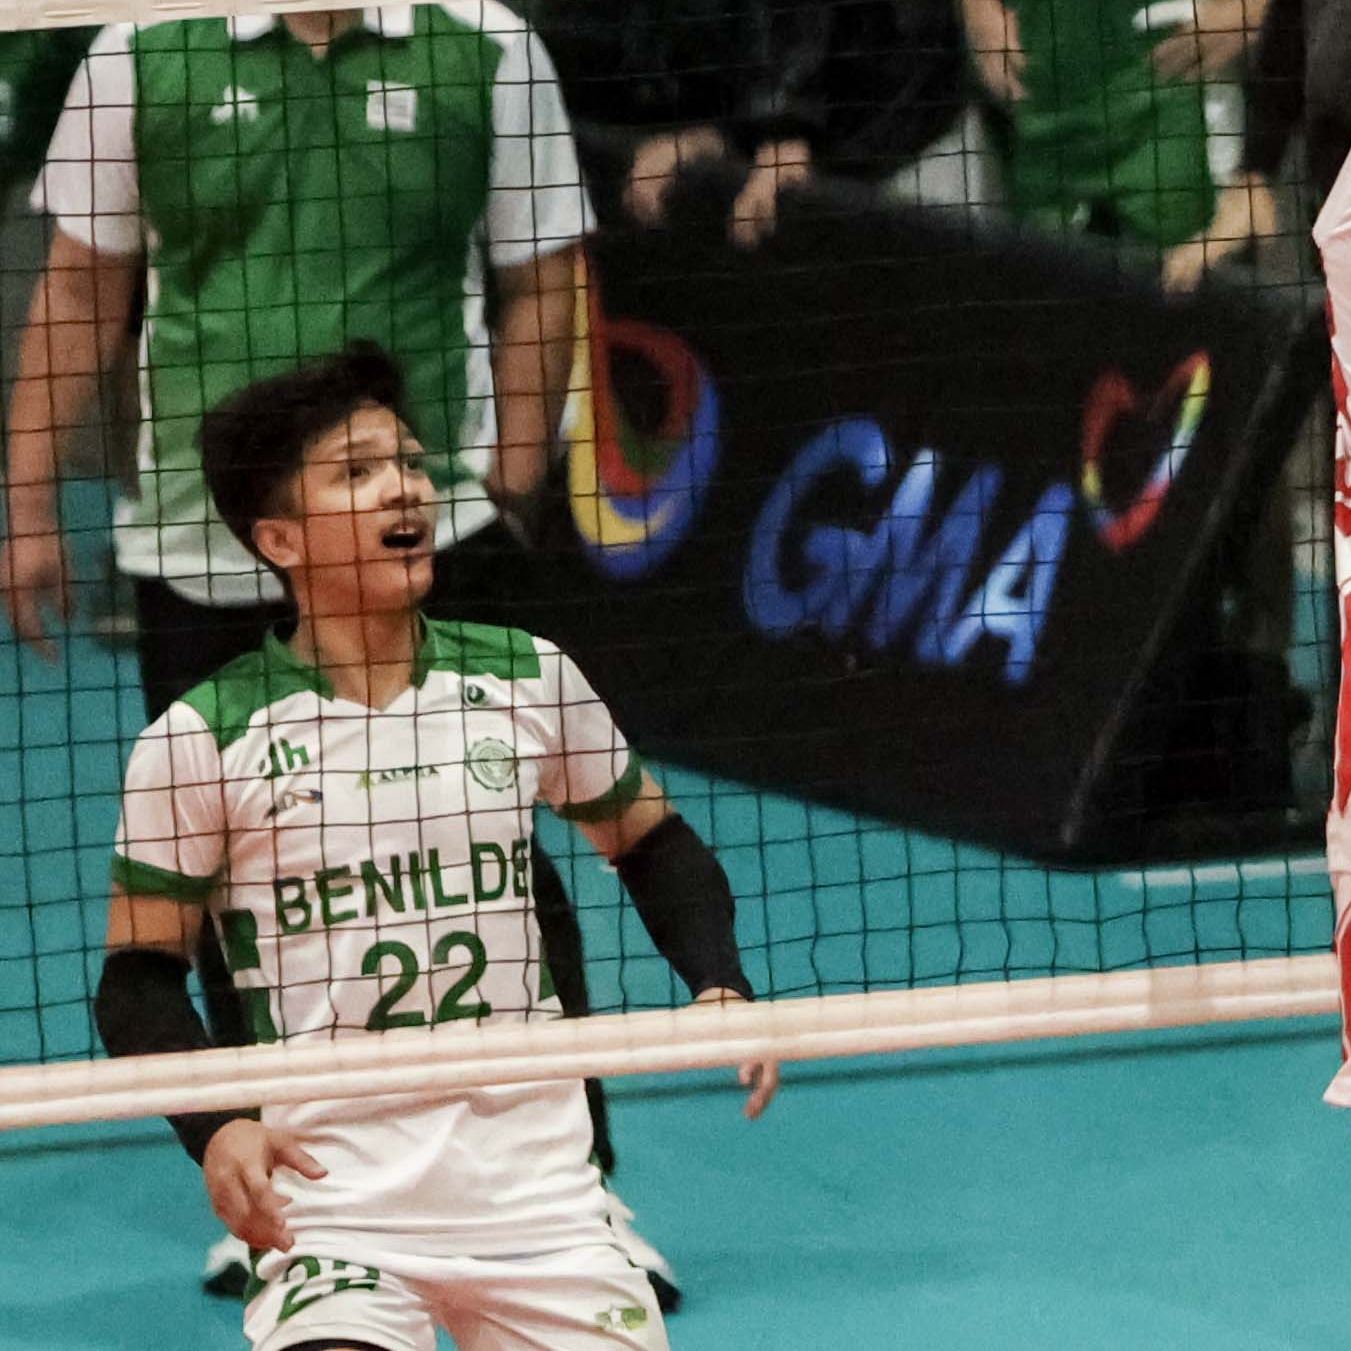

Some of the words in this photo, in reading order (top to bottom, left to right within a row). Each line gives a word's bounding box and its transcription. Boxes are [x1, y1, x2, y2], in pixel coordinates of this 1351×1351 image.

[743, 413, 1077, 686] GMA
[274, 838, 529, 935] BENILDE
[361, 930, 492, 1032] 22
